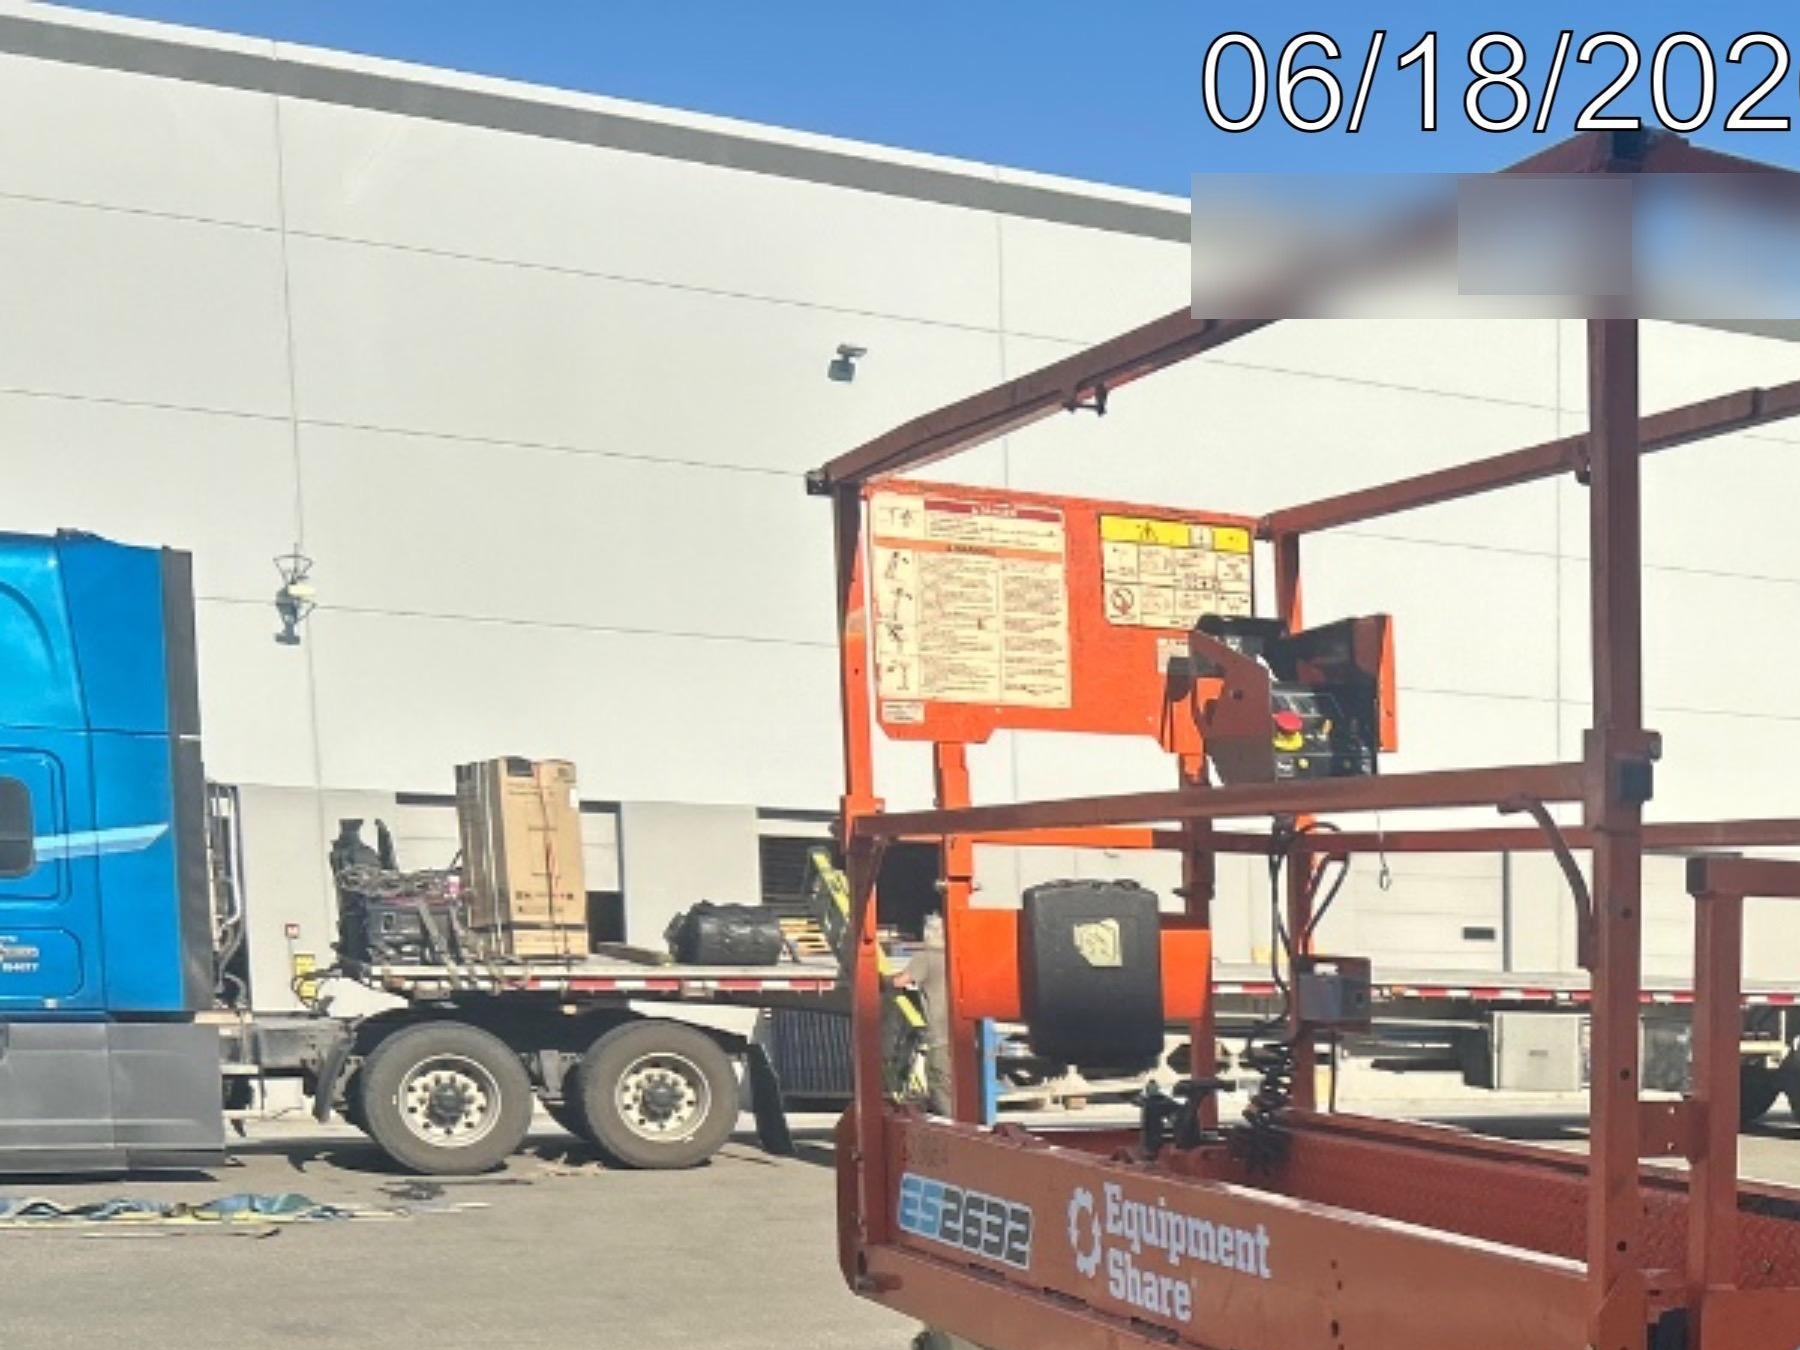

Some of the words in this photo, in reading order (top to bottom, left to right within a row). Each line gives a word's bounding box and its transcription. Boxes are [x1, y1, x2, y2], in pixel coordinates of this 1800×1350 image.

[899, 1173, 1034, 1270] ES2632
[1104, 1182, 1272, 1278] Equipment
[1108, 1247, 1193, 1322] Share
